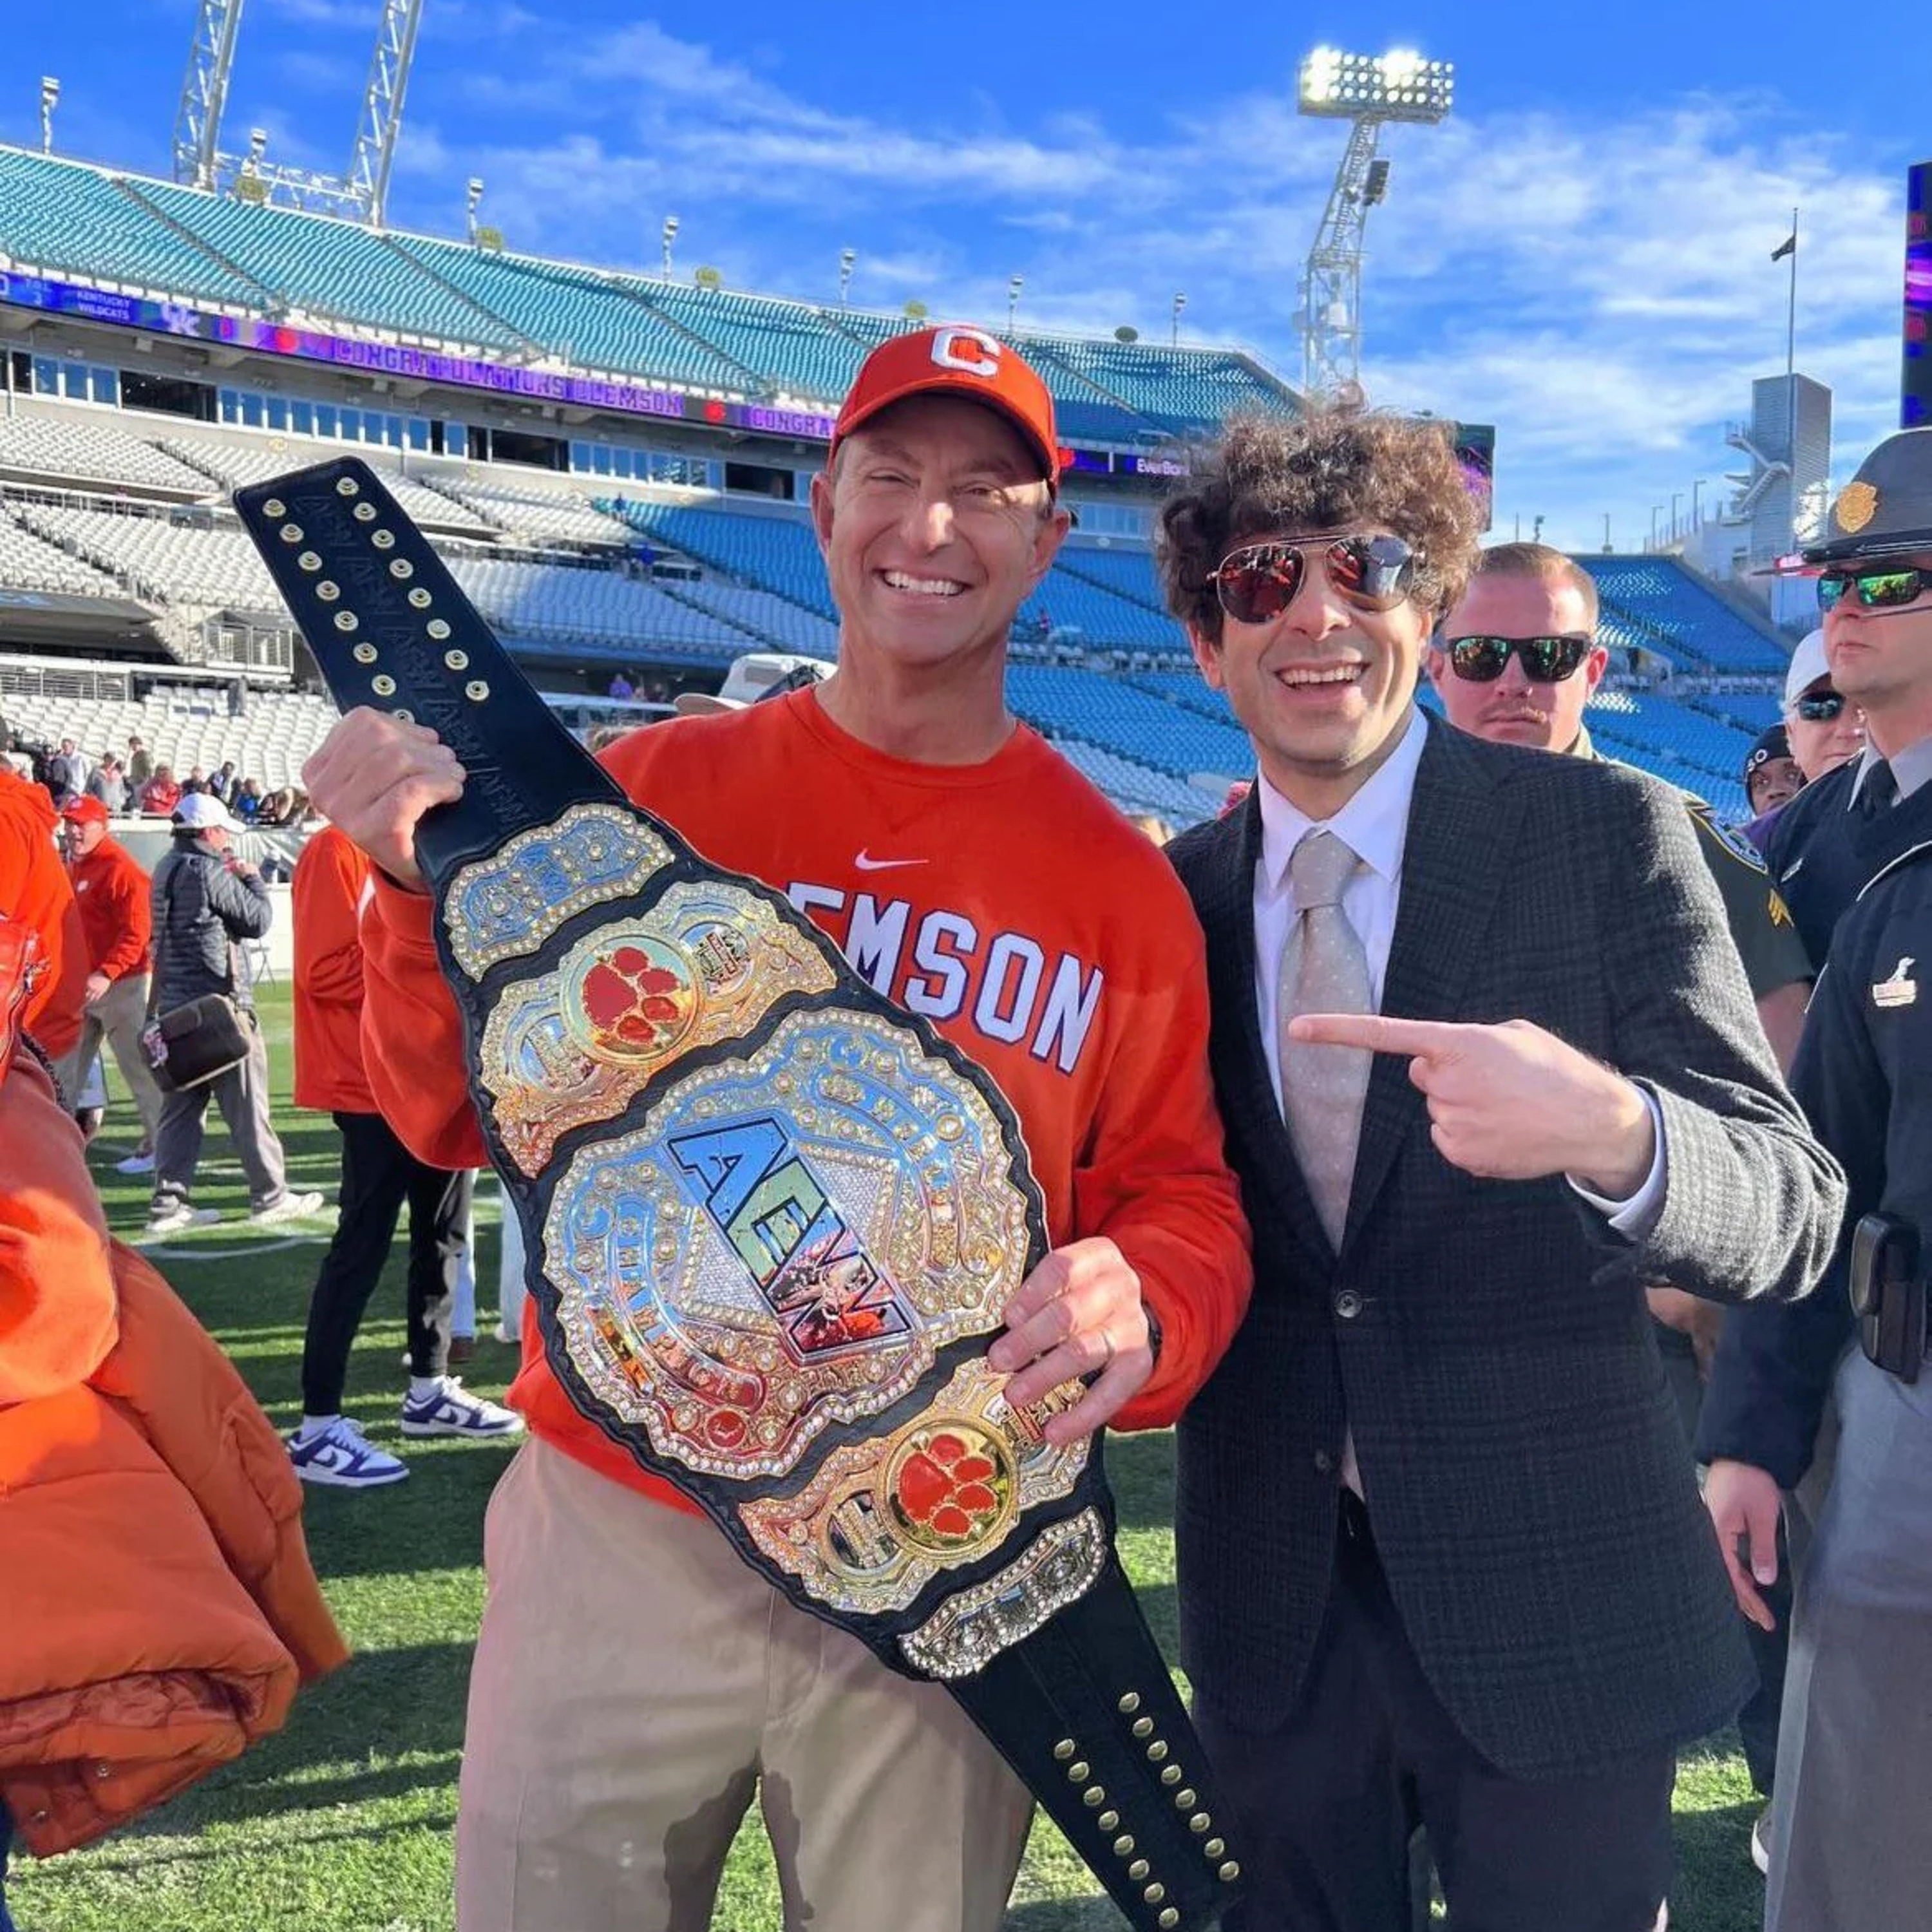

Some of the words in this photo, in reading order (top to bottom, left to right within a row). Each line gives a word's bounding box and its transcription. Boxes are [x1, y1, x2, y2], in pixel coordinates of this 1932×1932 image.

[77, 290, 130, 308] KENTUCKY
[78, 303, 130, 321] WILDCATS
[931, 327, 1000, 377] C
[666, 1117, 913, 1354] AEW
